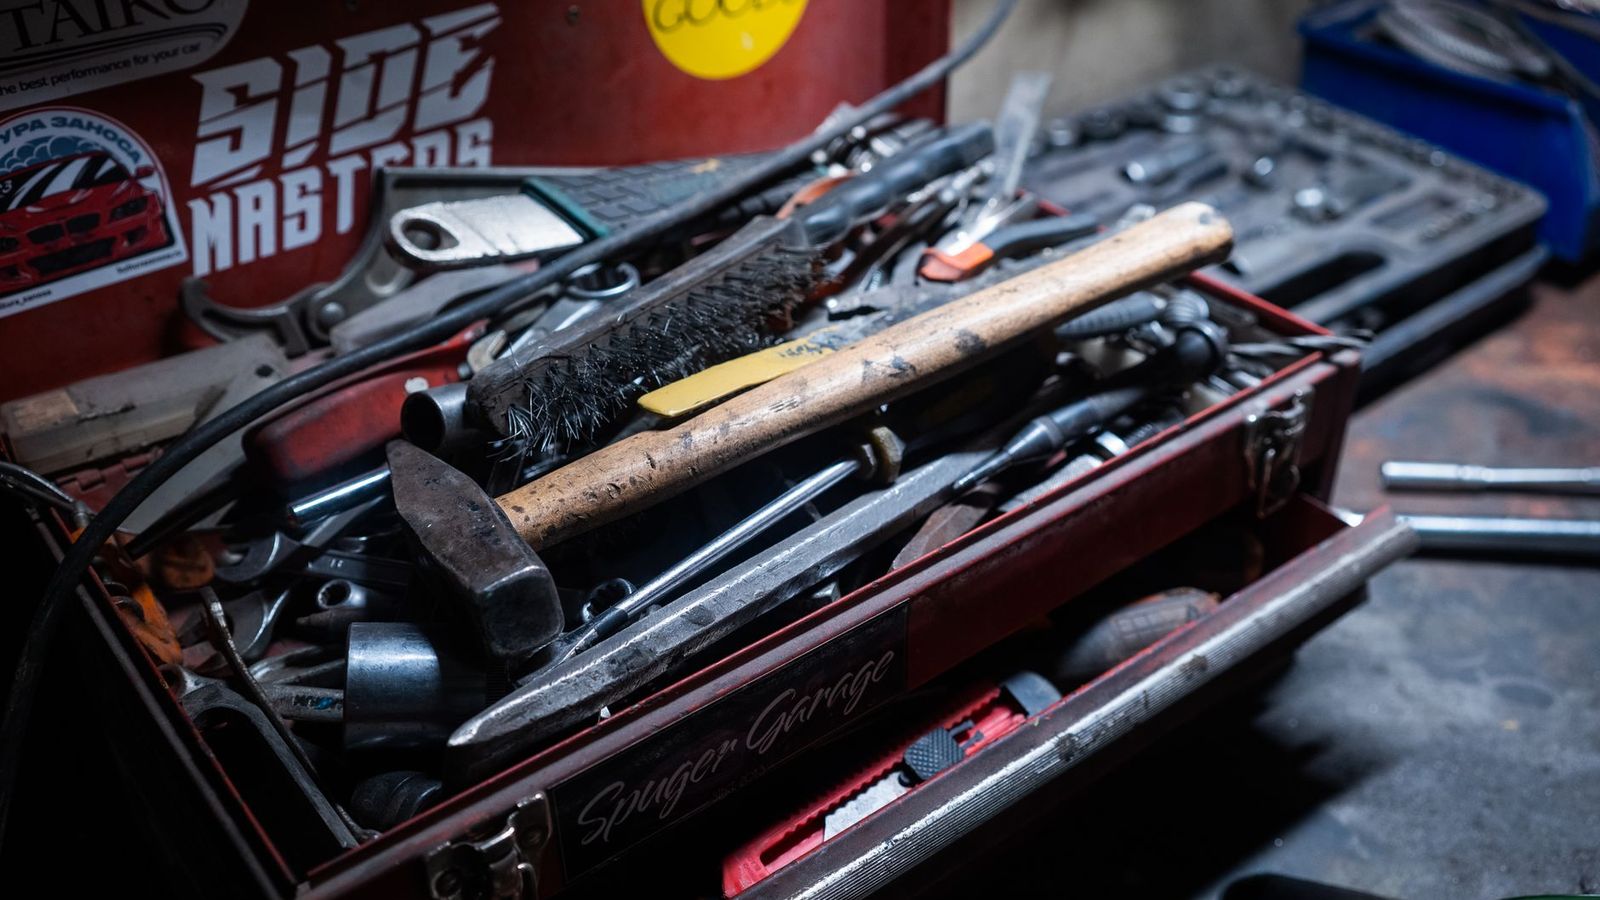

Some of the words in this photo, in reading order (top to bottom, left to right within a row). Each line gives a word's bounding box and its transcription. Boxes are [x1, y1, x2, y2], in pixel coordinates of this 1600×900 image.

[19, 76, 49, 92] best
[50, 60, 131, 86] performance
[133, 53, 149, 65] for
[152, 47, 180, 62] your
[182, 42, 201, 55] car
[190, 2, 502, 188] SIDE
[51, 116, 141, 164] ЗАНОСА
[746, 651, 894, 754] Garage
